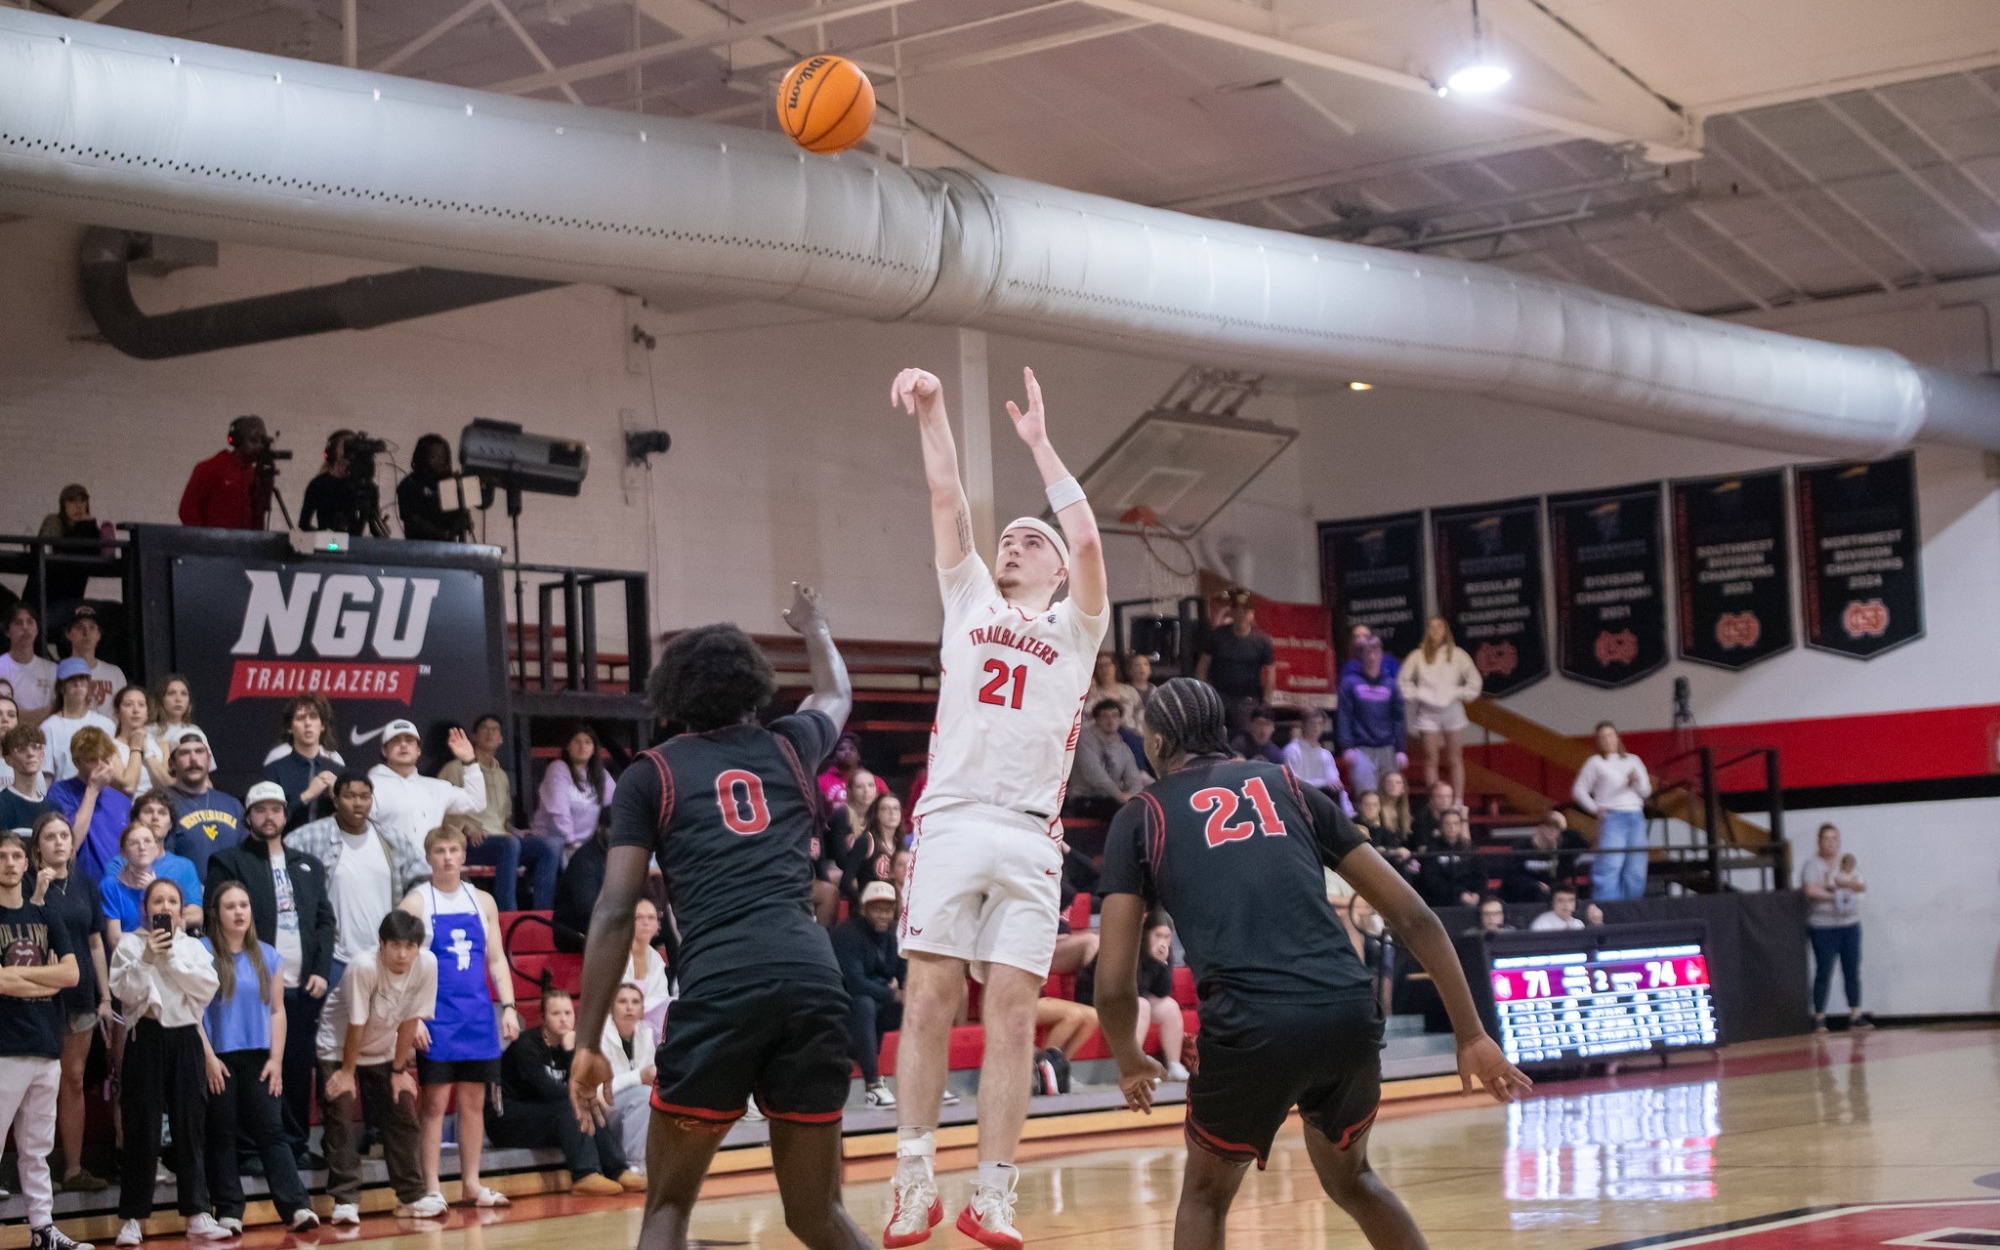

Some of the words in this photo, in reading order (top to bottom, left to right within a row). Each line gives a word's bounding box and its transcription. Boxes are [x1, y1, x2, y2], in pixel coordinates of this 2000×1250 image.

[789, 58, 829, 109] Wilson
[1707, 553, 1765, 569] DIVISION
[1834, 545, 1893, 561] DIVISION
[1699, 564, 1775, 583] CHAMPIONS
[1825, 557, 1904, 576] CHAMPIONS
[1464, 578, 1522, 594] REGULAR
[1584, 571, 1644, 588] DIVISION
[1351, 595, 1407, 612] DIVISION
[1470, 593, 1520, 608] SEASON
[1576, 586, 1652, 604] CHAMPIONS
[230, 570, 440, 658] NGU
[1460, 606, 1531, 623] CHAMPIONS
[969, 625, 1059, 665] TRAILBLAZERS
[245, 666, 400, 692] TRAILBLAZERS
[419, 664, 431, 675] TM
[978, 657, 1028, 709] 21
[716, 768, 772, 836] 0
[1189, 776, 1288, 848] 21
[1522, 970, 1551, 998] 71
[1594, 970, 1609, 991] 2
[1645, 961, 1677, 988] 74
